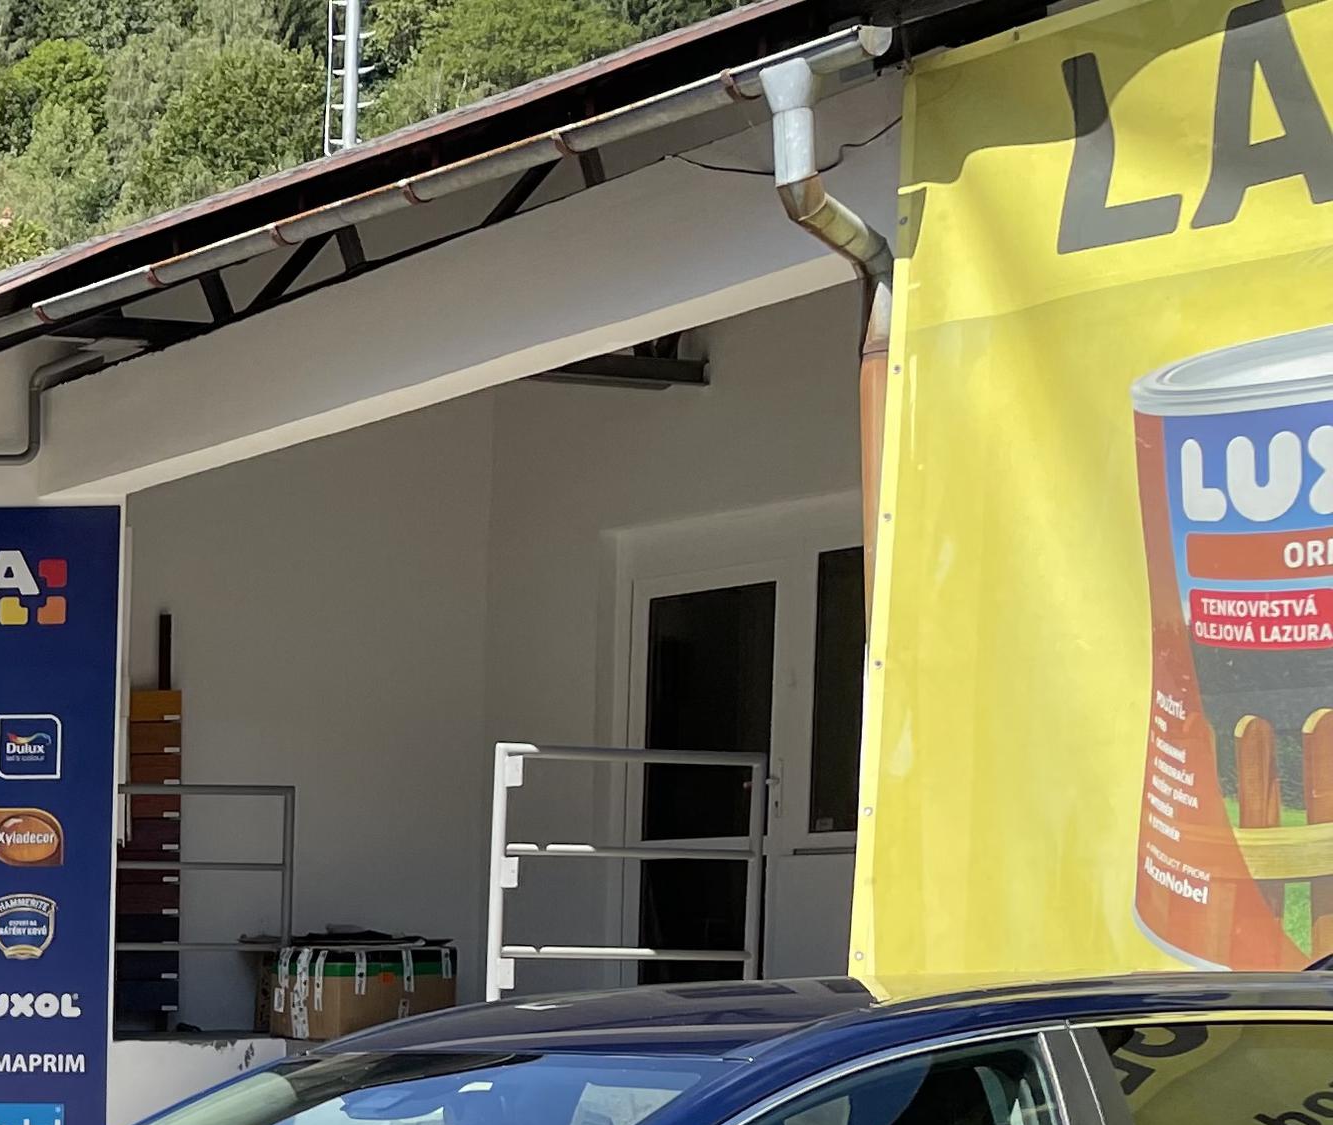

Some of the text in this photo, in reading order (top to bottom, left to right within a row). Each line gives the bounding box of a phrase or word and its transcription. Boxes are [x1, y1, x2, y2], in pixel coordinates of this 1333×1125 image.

[1201, 594, 1318, 618] TENKOVRSTVÁ
[1195, 620, 1333, 642] OLEJOVÁ LAZURA
[6, 742, 45, 755] Dulux
